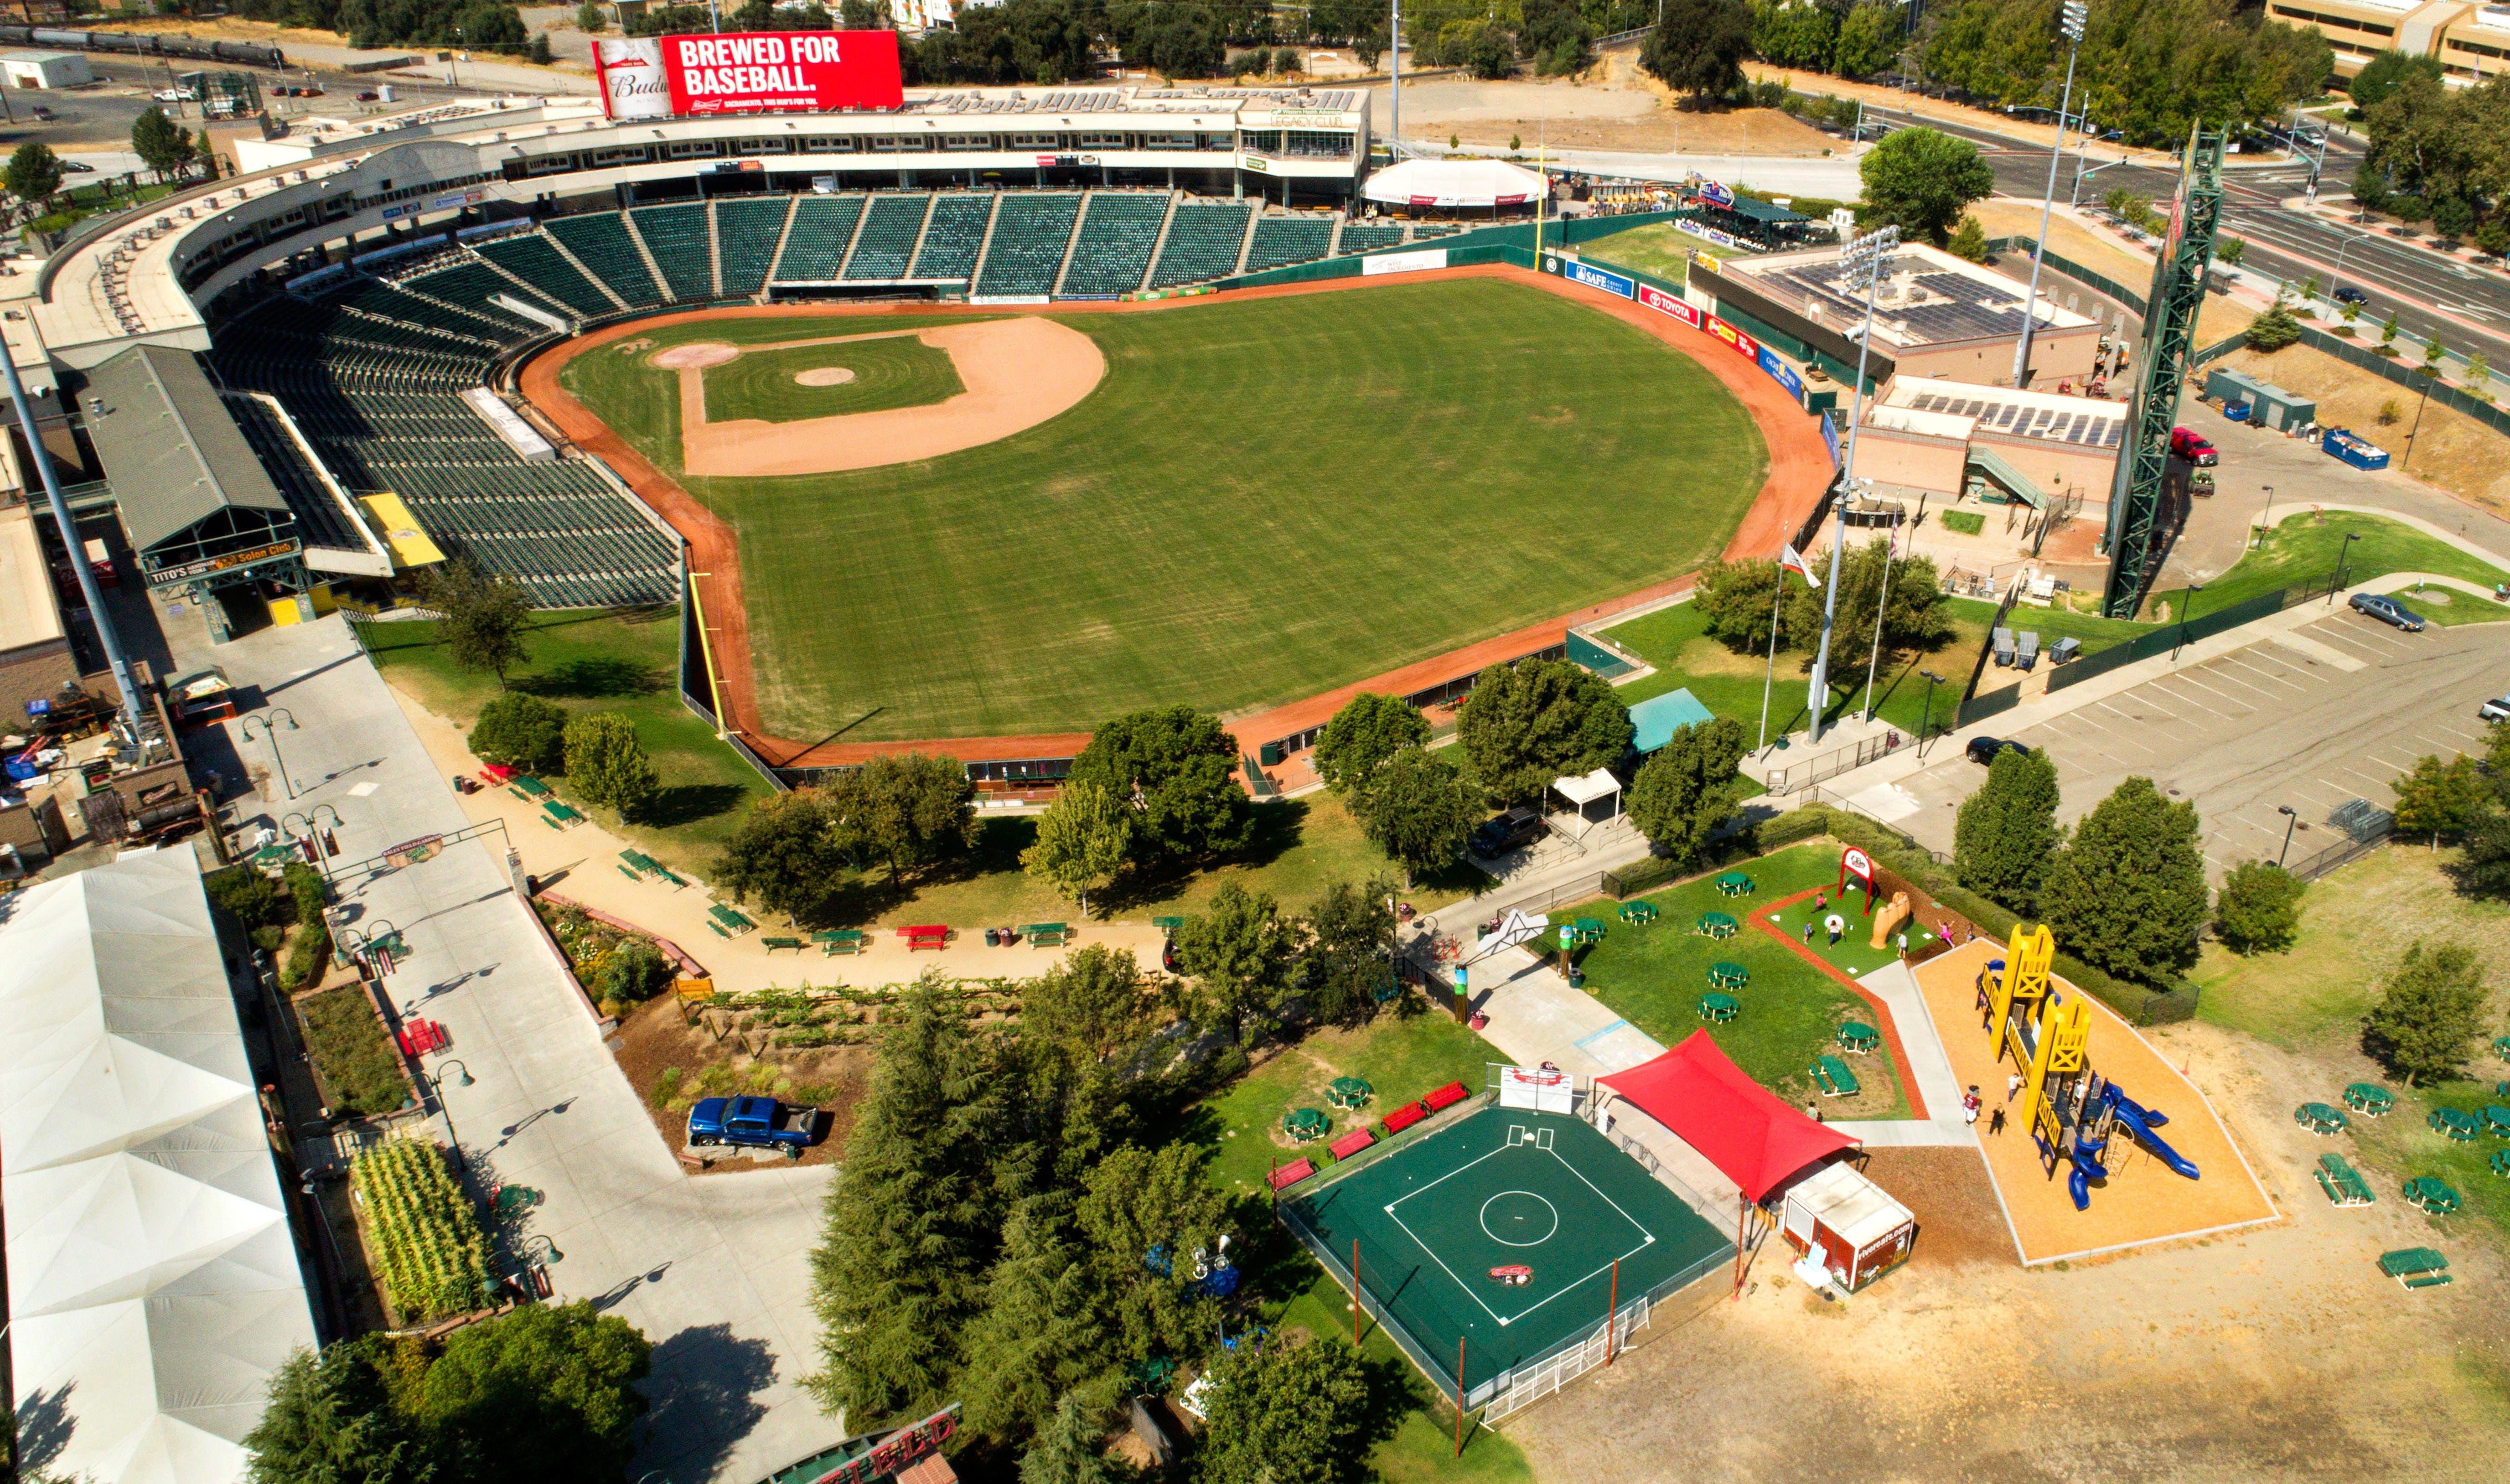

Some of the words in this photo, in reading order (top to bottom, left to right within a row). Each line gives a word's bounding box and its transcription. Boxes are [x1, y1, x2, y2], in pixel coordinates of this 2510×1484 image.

[679, 38, 786, 67] BREWED
[791, 36, 840, 64] FOR
[684, 66, 816, 95] BASEBALL.
[724, 99, 763, 107] SACRAMENTO,
[1270, 116, 1313, 127] LEGACY
[1315, 116, 1342, 128] CLUB
[1548, 260, 1555, 270] 42
[1585, 271, 1607, 287] SAFE
[1661, 297, 1690, 319] TOYOTA
[238, 549, 267, 562] Solon
[269, 543, 291, 555] Club
[151, 567, 187, 583] TITO'S
[1858, 1222, 1911, 1261] rivercats.com
